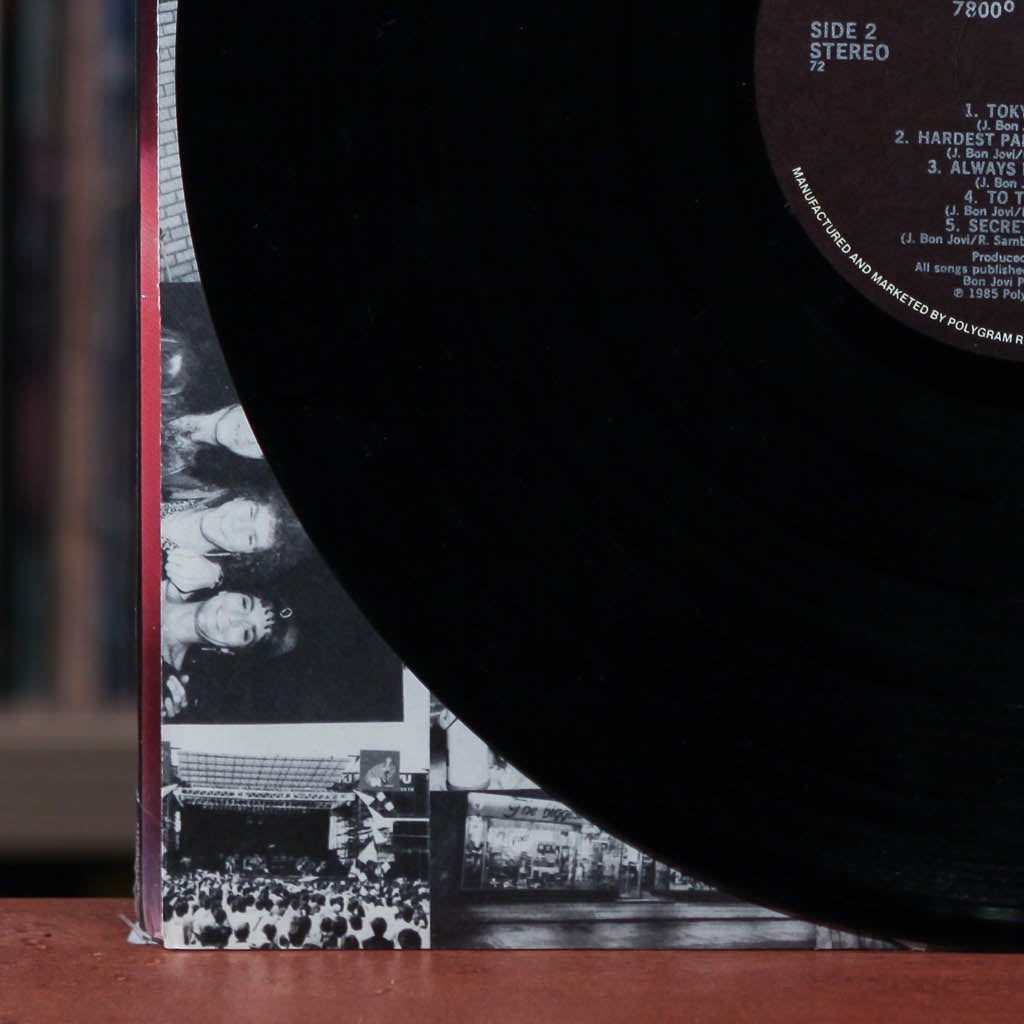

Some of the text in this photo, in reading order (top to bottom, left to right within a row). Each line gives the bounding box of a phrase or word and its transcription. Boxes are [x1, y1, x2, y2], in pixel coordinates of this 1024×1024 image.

[810, 21, 877, 40] SIDE 2
[810, 42, 889, 61] STEREO
[809, 60, 825, 71] 72
[965, 103, 978, 118] 1.
[977, 120, 990, 131] (J.
[995, 120, 1018, 131] Bon
[894, 130, 909, 144] 2.
[918, 130, 994, 146] HARDEST
[946, 148, 960, 159] (J.
[966, 148, 988, 159] Bon
[928, 160, 941, 174] 3.
[950, 161, 1016, 176] ALWAYS
[975, 177, 989, 189] (J.
[995, 177, 1017, 188] Bon
[964, 190, 977, 203] 4.
[987, 190, 1008, 205] TO
[945, 205, 959, 216] (J.
[964, 206, 987, 216] Bon
[945, 218, 960, 232] 5.
[901, 232, 915, 245] (J.
[920, 233, 943, 244] Bon
[948, 234, 989, 246] Jovi/R.
[792, 166, 851, 254] MANUFACTURED
[849, 253, 872, 274] AND
[870, 271, 929, 315] MARKETED
[930, 309, 947, 323] BY
[947, 317, 1013, 344] POLYGRAM
[915, 262, 930, 273] All
[934, 264, 968, 275] songs
[963, 275, 985, 286] Bon
[990, 276, 1013, 287] Jovi
[969, 288, 998, 298] 1985
